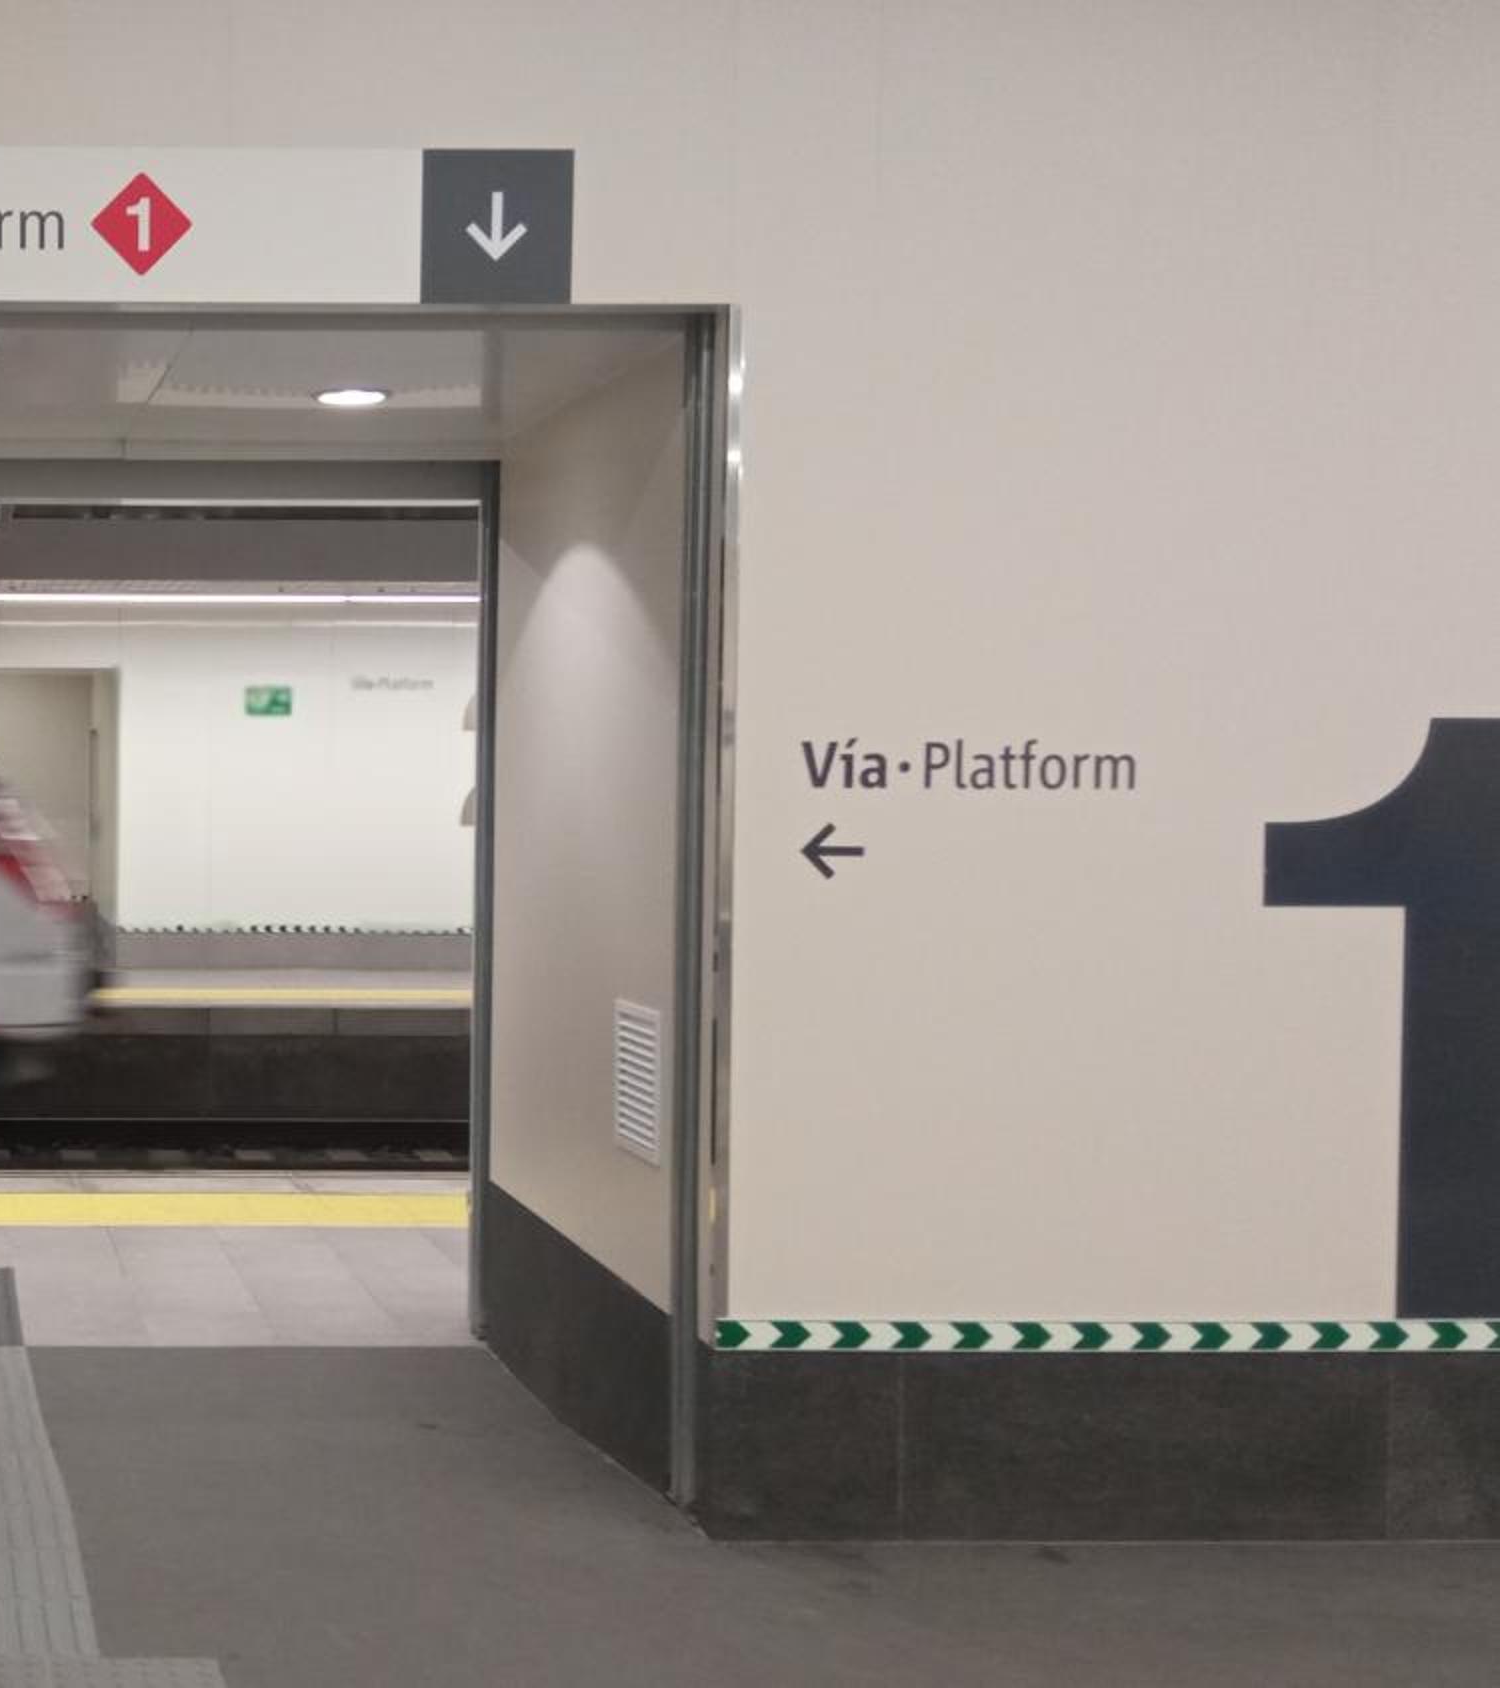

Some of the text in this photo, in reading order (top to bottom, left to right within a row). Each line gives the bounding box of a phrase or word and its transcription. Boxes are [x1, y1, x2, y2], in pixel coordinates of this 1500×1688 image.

[125, 196, 152, 252] 1
[801, 737, 888, 790] Vía
[923, 739, 1137, 790] Platform
[1263, 717, 1500, 1319] 1
